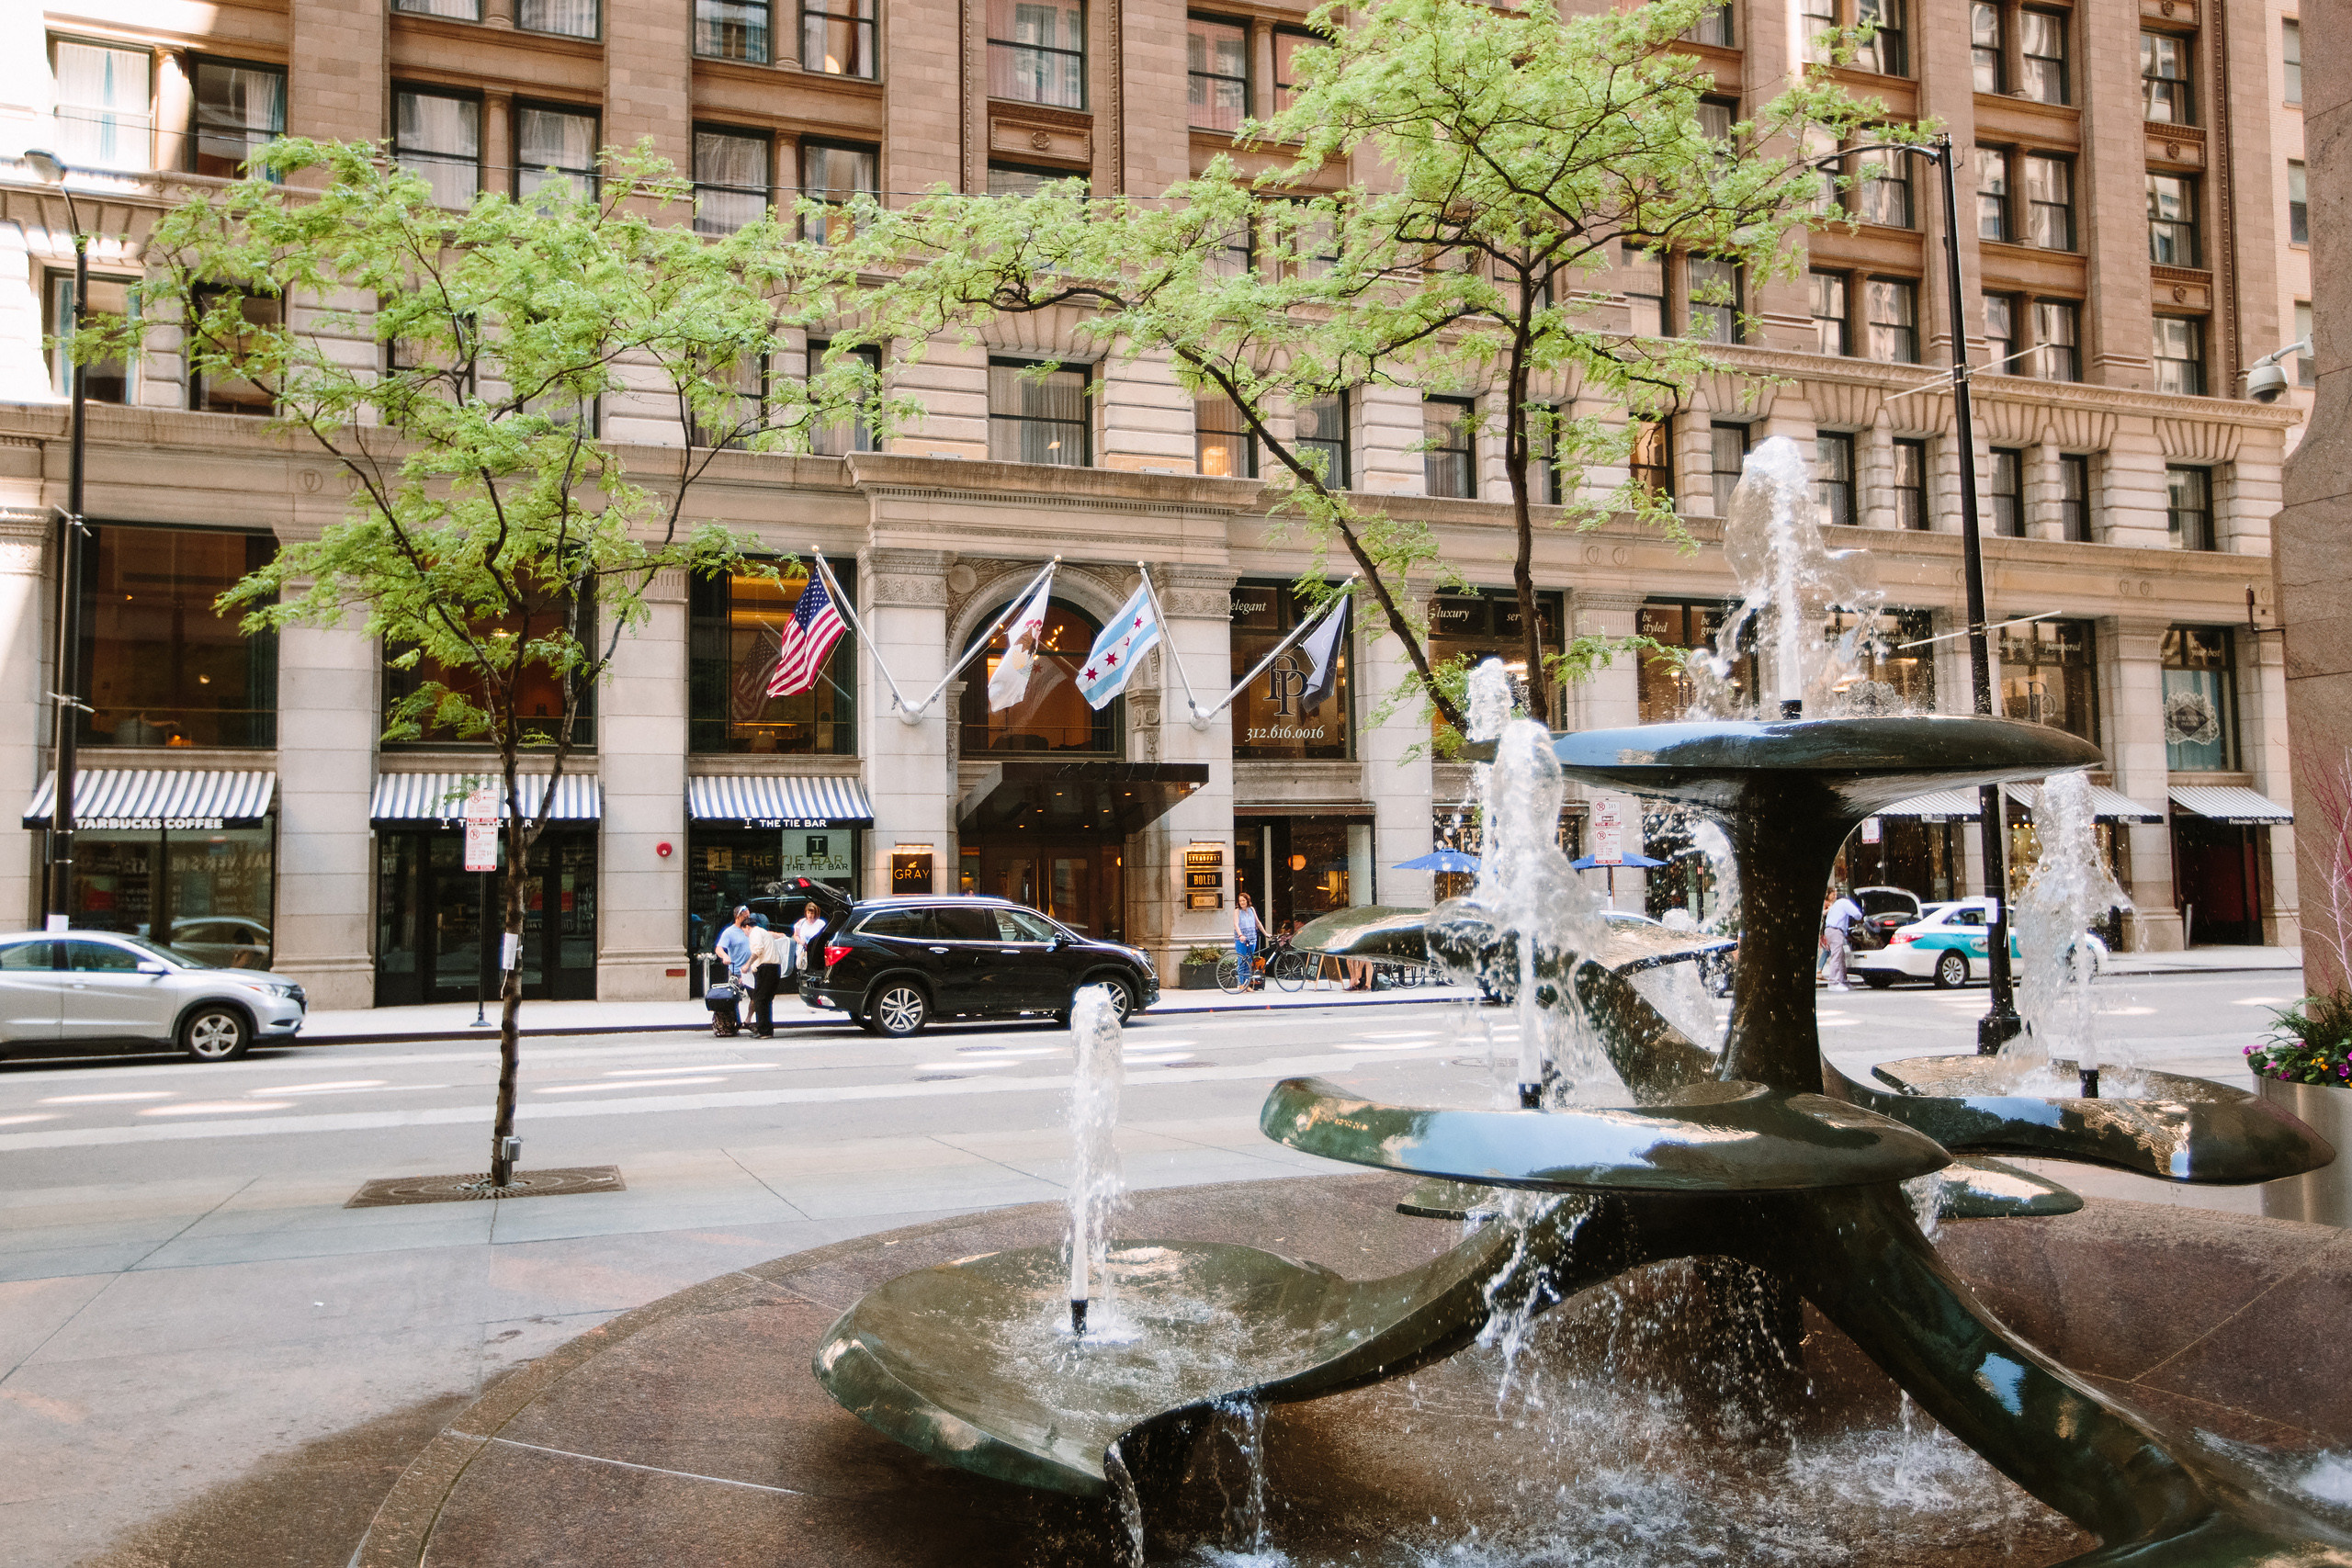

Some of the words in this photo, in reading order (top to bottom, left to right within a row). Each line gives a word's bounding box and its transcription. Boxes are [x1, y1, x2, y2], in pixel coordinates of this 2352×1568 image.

[1230, 599, 1267, 615] elegant
[1436, 606, 1470, 622] luxury
[1642, 611, 1652, 622] be
[1701, 615, 1710, 625] be
[1642, 622, 1668, 636] styled
[1245, 725, 1325, 742] 312.616.0016
[75, 818, 162, 829] TARBUCKS
[164, 818, 223, 829] COFFEE
[760, 819, 781, 828] THE
[783, 819, 800, 828] TIE
[804, 819, 827, 828] BAR
[894, 868, 930, 879] GRAY
[1193, 874, 1216, 886] BOLEO
